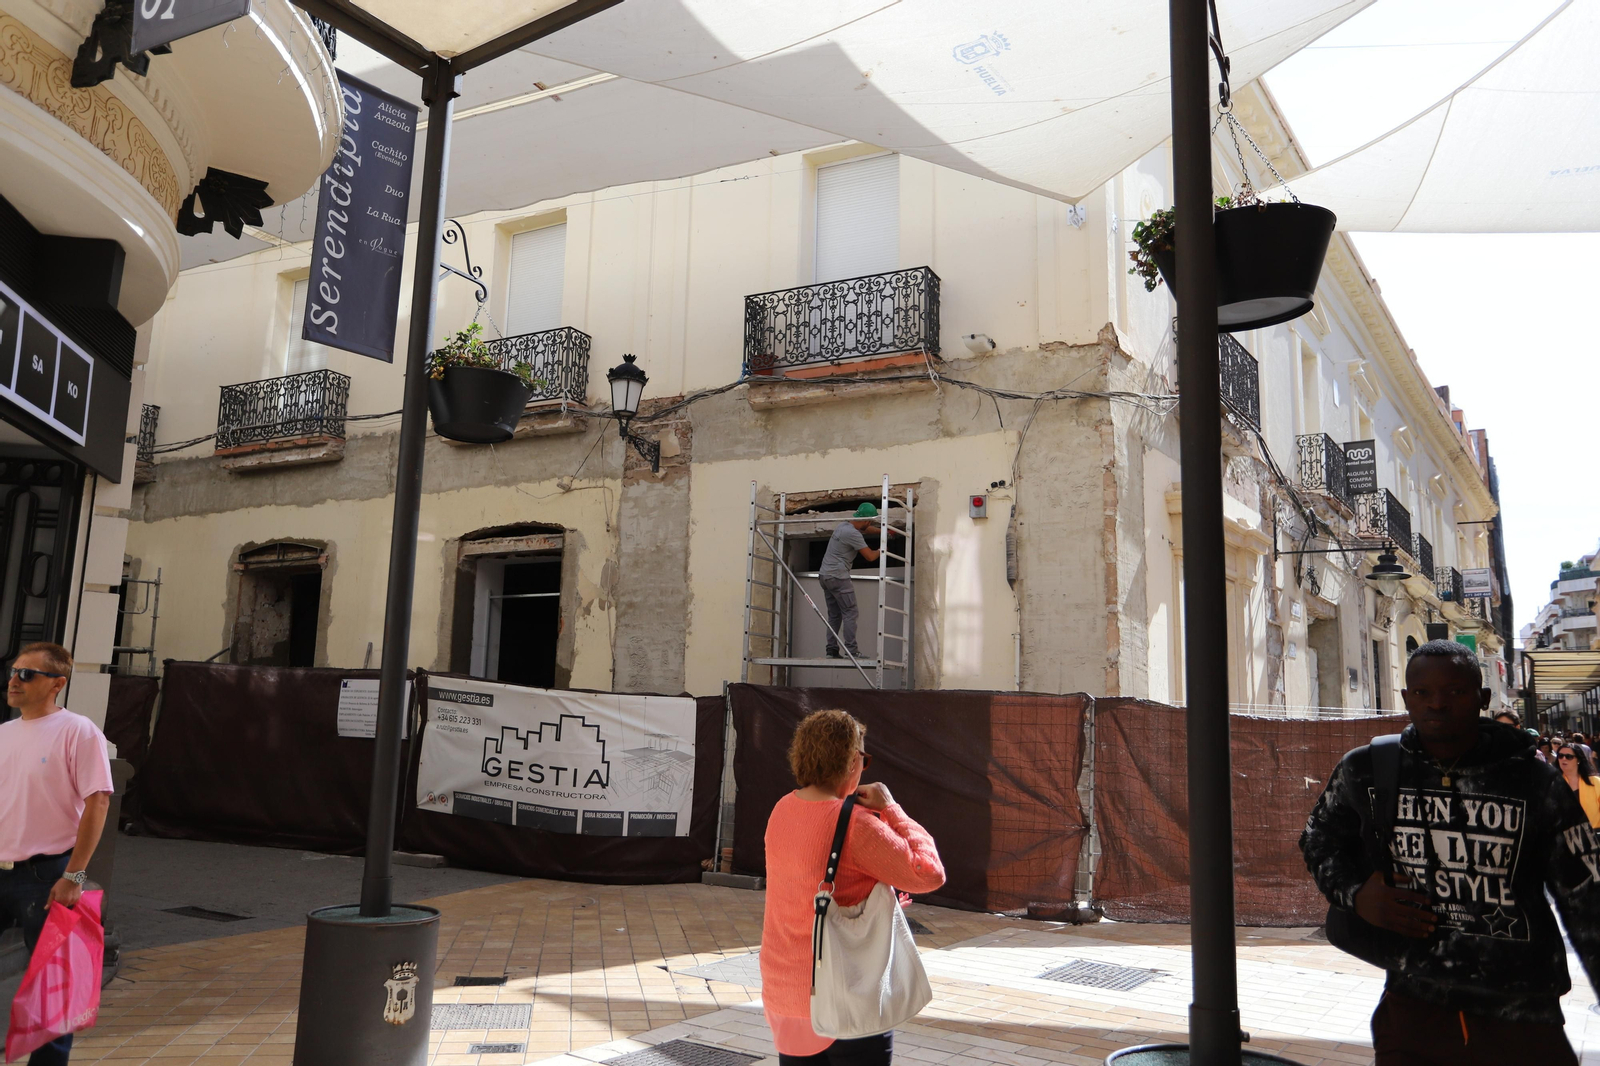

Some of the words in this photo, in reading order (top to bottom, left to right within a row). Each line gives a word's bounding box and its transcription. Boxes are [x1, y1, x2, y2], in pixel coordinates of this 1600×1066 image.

[973, 65, 1007, 97] HUELVA
[378, 102, 407, 120] Alicia
[374, 111, 411, 133] Arazola
[371, 140, 408, 162] Cachito
[374, 151, 403, 168] (Eventos)
[384, 184, 404, 199] Duo
[310, 88, 363, 335] Serendipia
[366, 206, 380, 218] La
[381, 212, 402, 226] Rua
[31, 354, 43, 375] SA
[67, 380, 78, 399] KO
[438, 690, 491, 705] www.gestia.es
[458, 716, 470, 724] 223
[484, 756, 607, 789] GESTIA
[483, 780, 524, 792] EMPRESA
[525, 787, 607, 800] CONSTRUCTORA
[1396, 793, 1451, 823] HEN
[1461, 798, 1522, 832] YOU
[1434, 870, 1515, 906] STYLE
